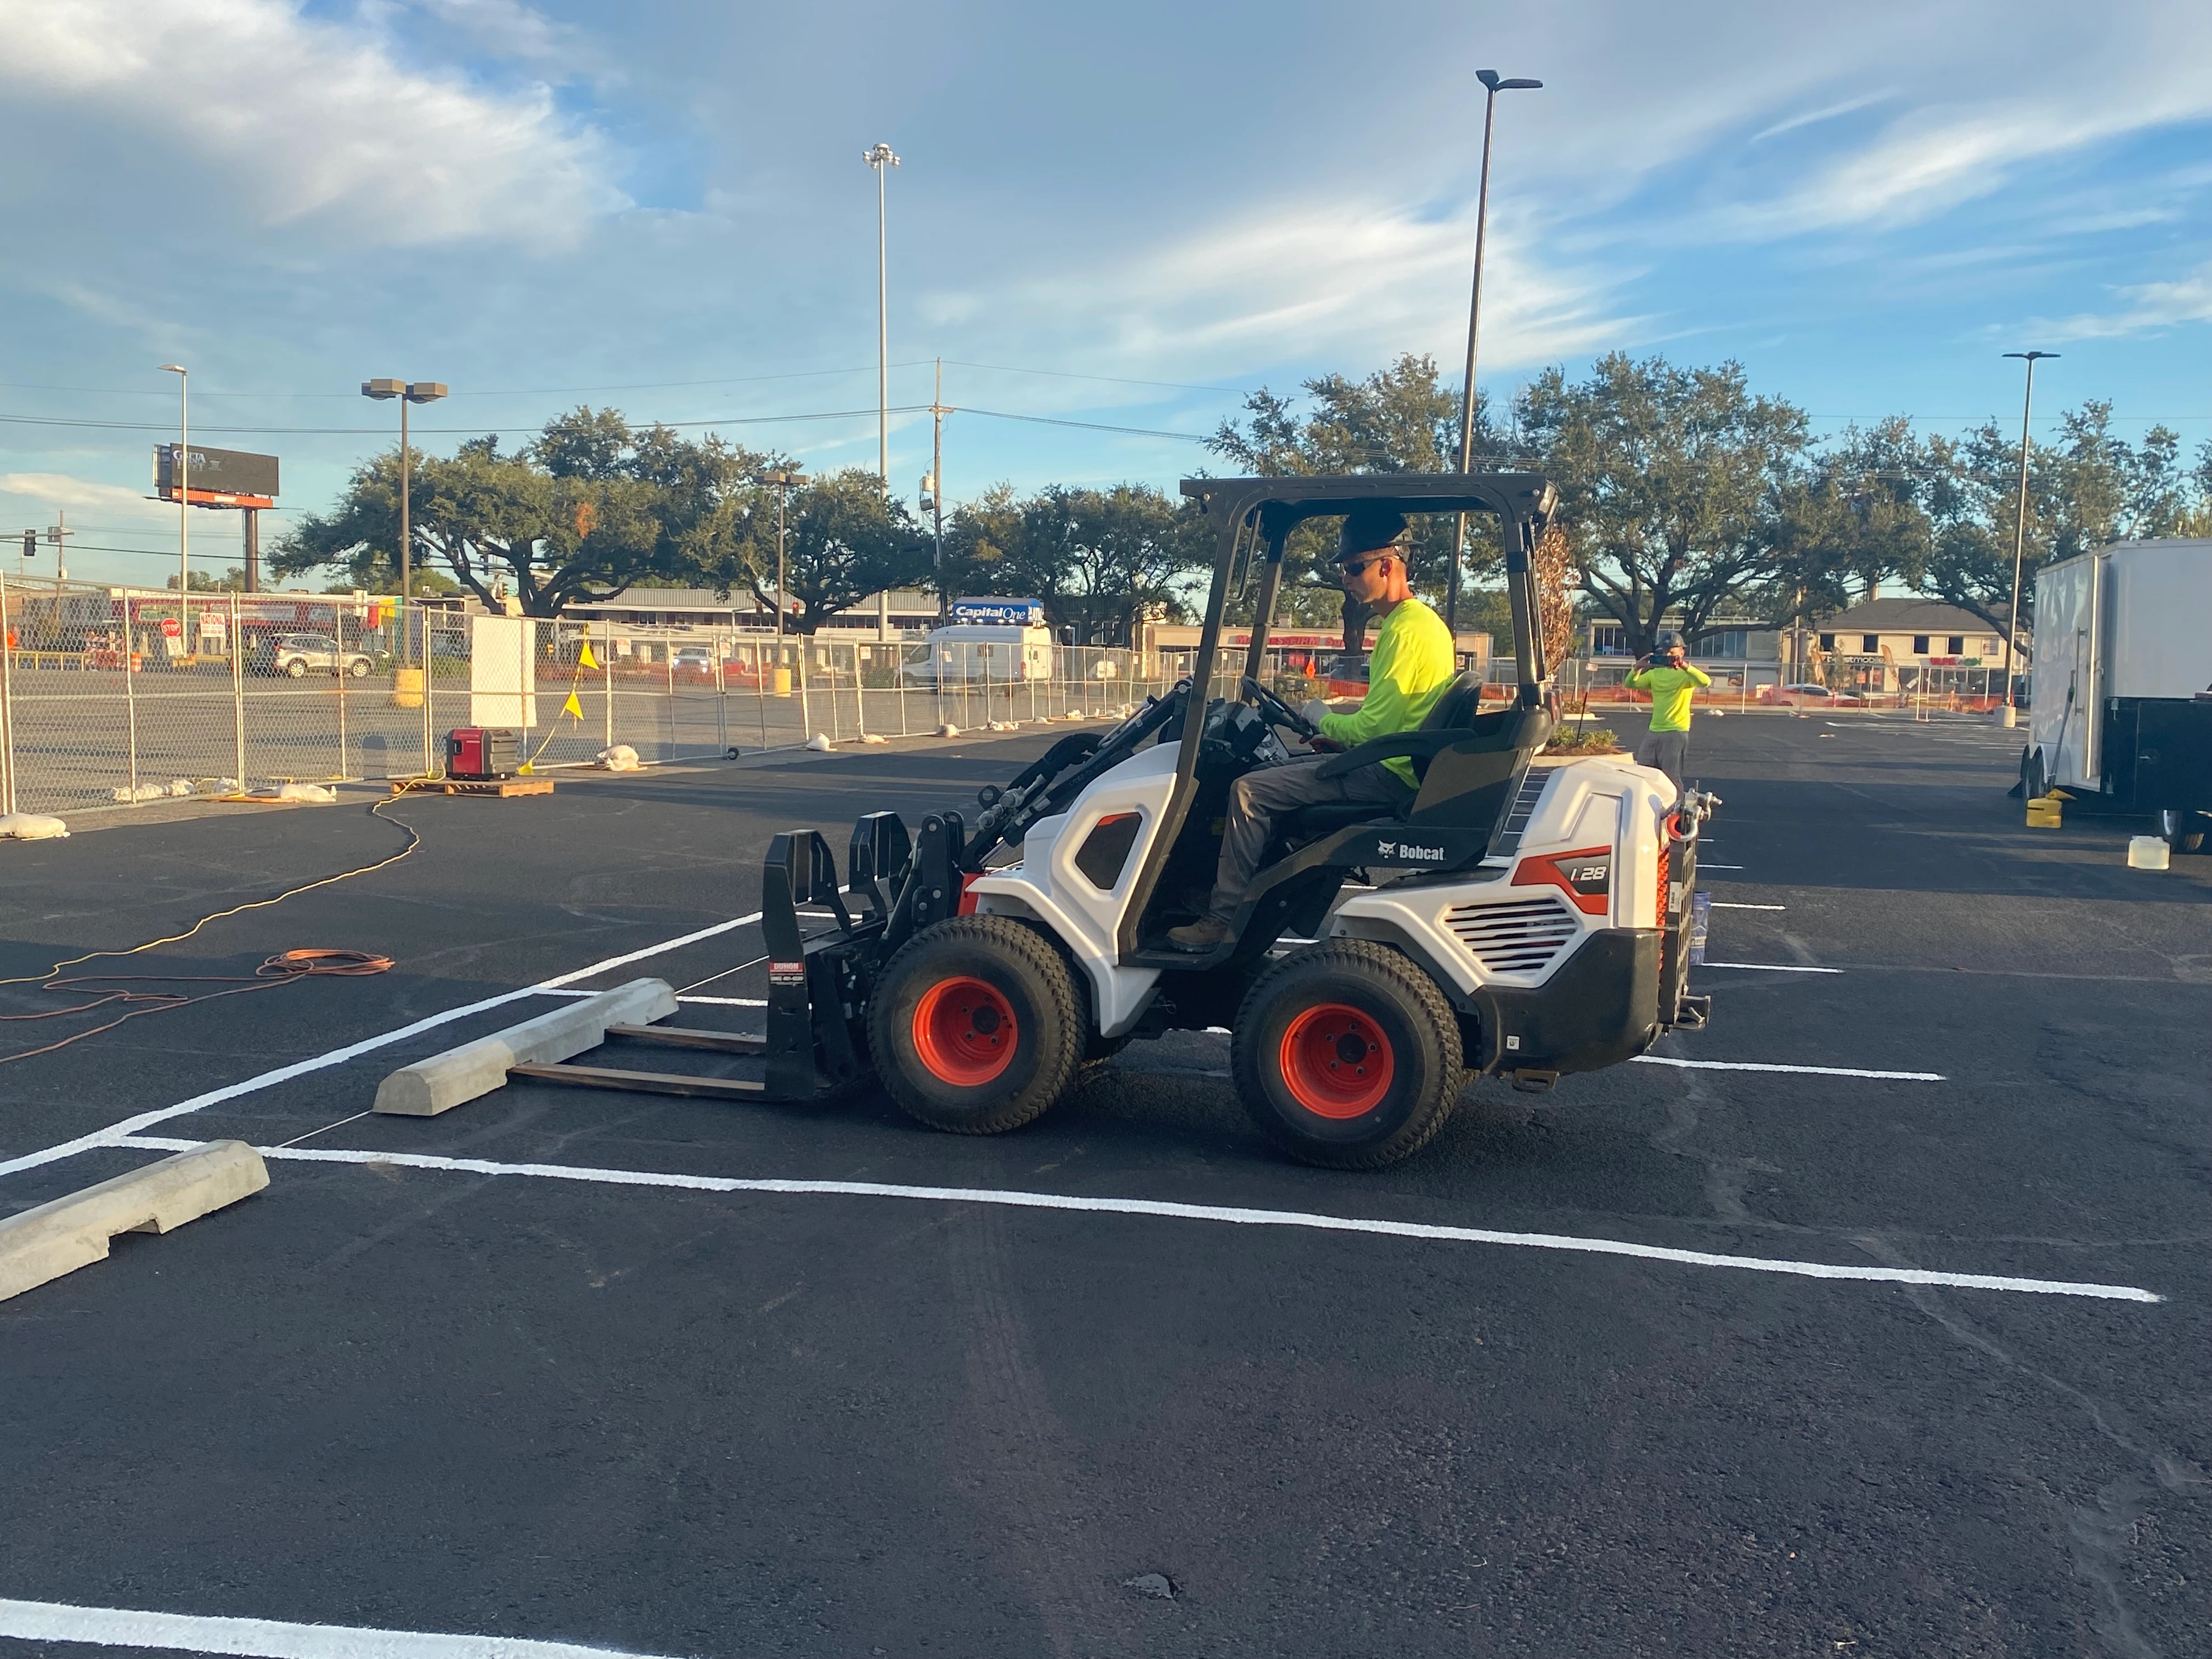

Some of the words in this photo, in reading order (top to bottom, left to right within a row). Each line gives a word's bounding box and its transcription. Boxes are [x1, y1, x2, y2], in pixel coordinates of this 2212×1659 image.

[201, 614, 224, 625] NATIONAL
[162, 624, 179, 633] STOP
[1290, 636, 1319, 645] FIRM
[1400, 844, 1444, 861] Bobcat
[1570, 866, 1607, 882] L28
